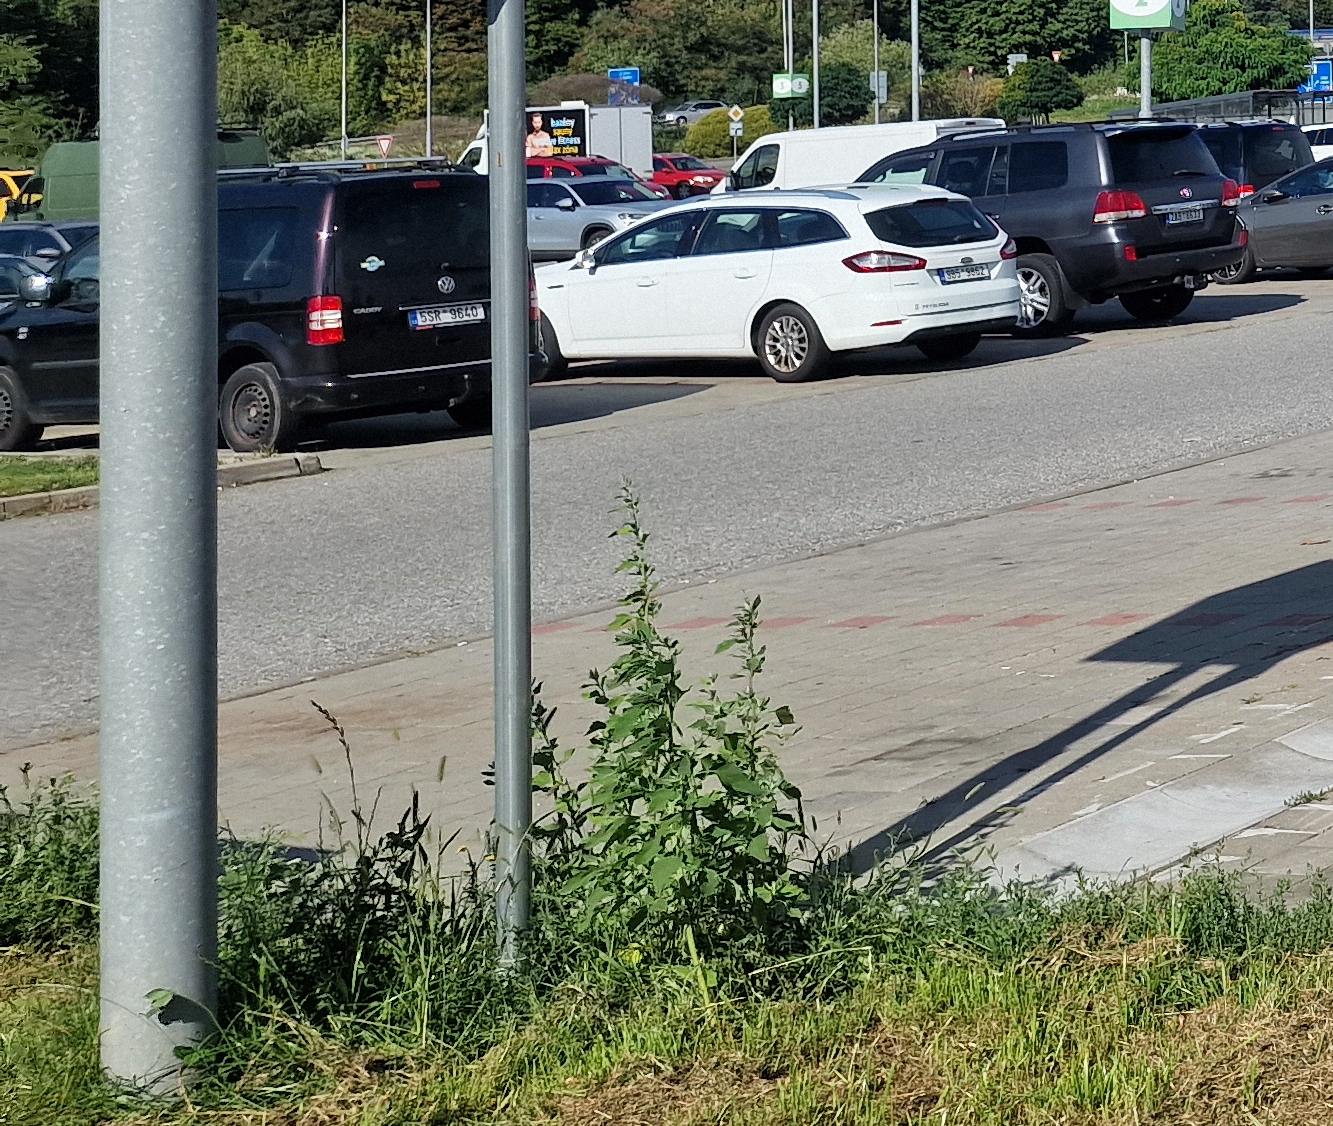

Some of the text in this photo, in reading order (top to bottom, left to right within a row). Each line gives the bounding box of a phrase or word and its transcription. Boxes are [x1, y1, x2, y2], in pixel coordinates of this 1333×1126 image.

[353, 306, 383, 315] CADDY
[420, 305, 479, 323] 5SR 9640
